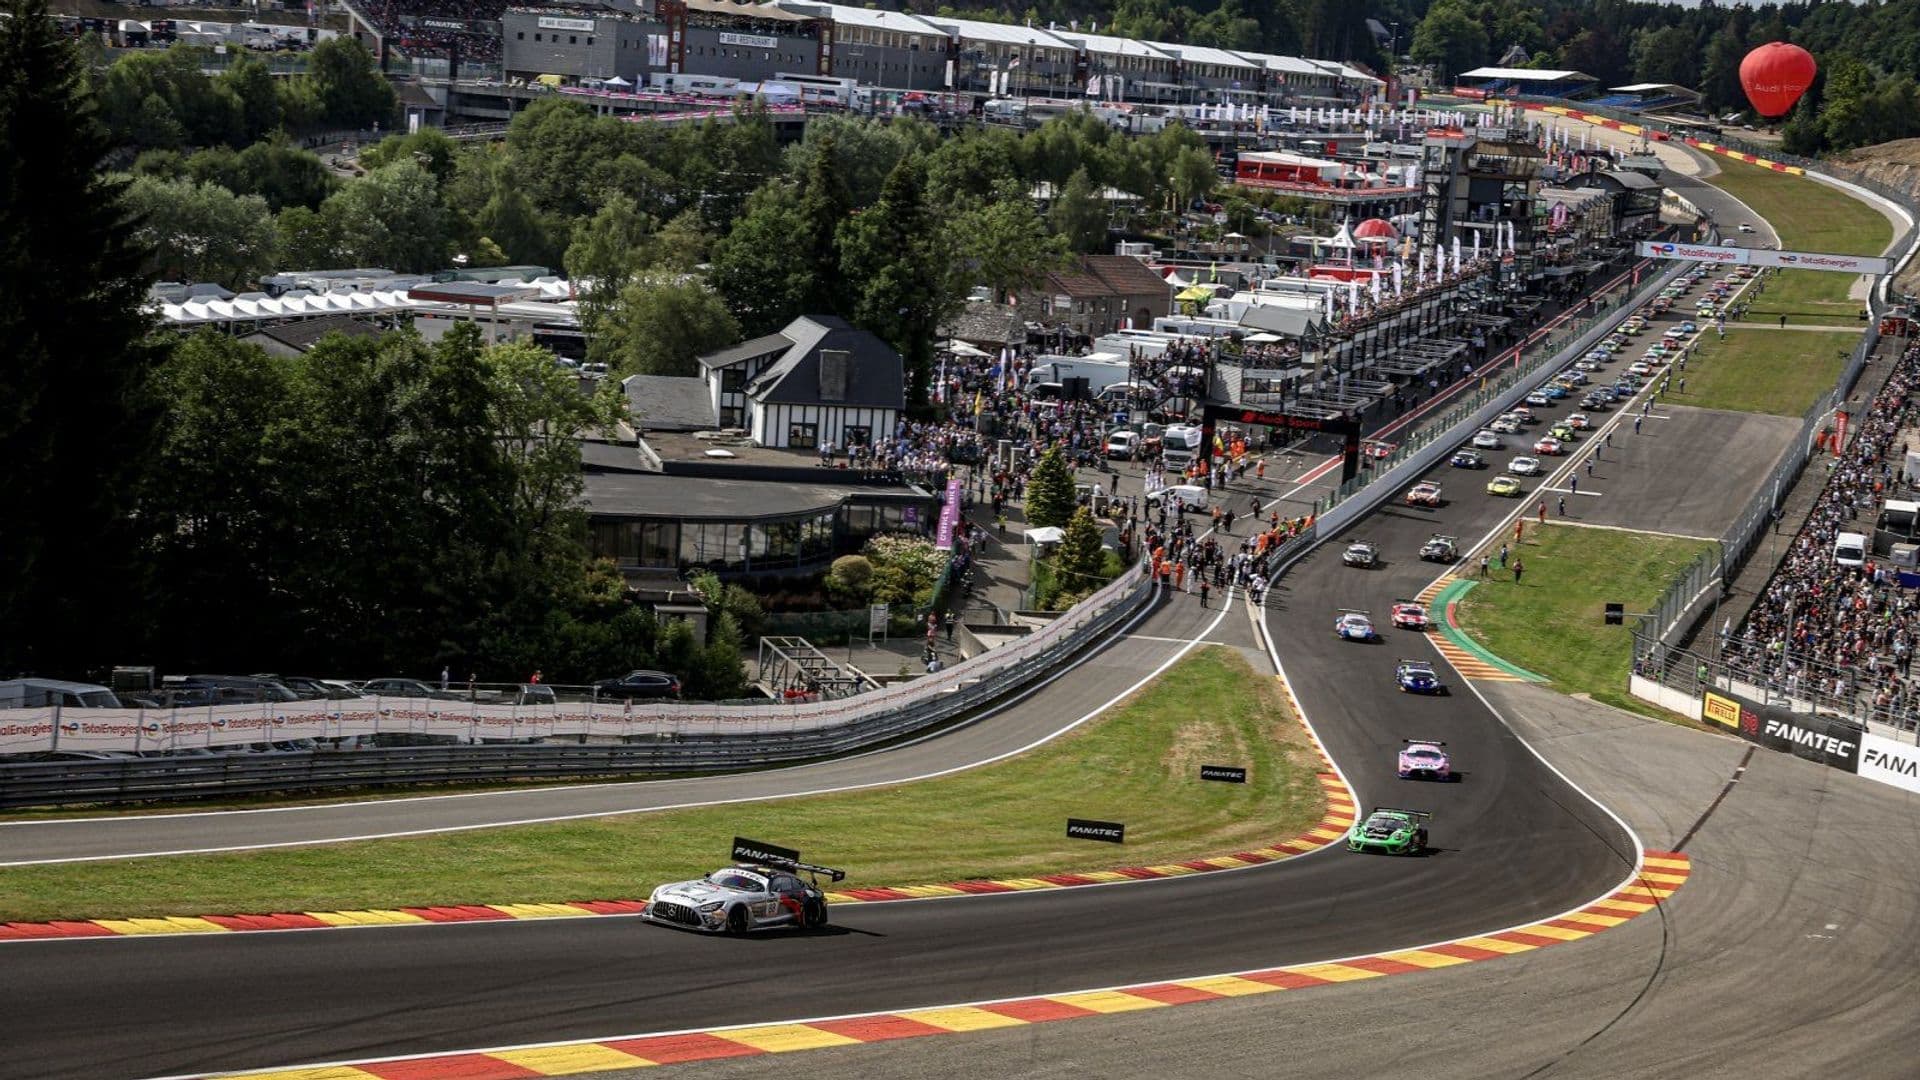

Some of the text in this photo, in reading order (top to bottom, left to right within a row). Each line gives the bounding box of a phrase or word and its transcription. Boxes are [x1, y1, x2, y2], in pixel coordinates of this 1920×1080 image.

[424, 19, 463, 30] FANATEC
[727, 34, 771, 47] BAR RESTAURANT
[1754, 83, 1780, 93] Audi
[1677, 248, 1737, 261] TotalEnergies
[1800, 256, 1857, 268] TotalEnergies
[1288, 416, 1321, 429] Sport
[1708, 697, 1737, 722] PIRELLI
[81, 722, 139, 737] TotalEnergies
[161, 721, 209, 735] TotalEnergies
[227, 717, 272, 730] TotalEnergies
[1765, 720, 1855, 758] FANATEC
[1202, 770, 1244, 778] FANATEC
[1069, 826, 1122, 837] FANATEC
